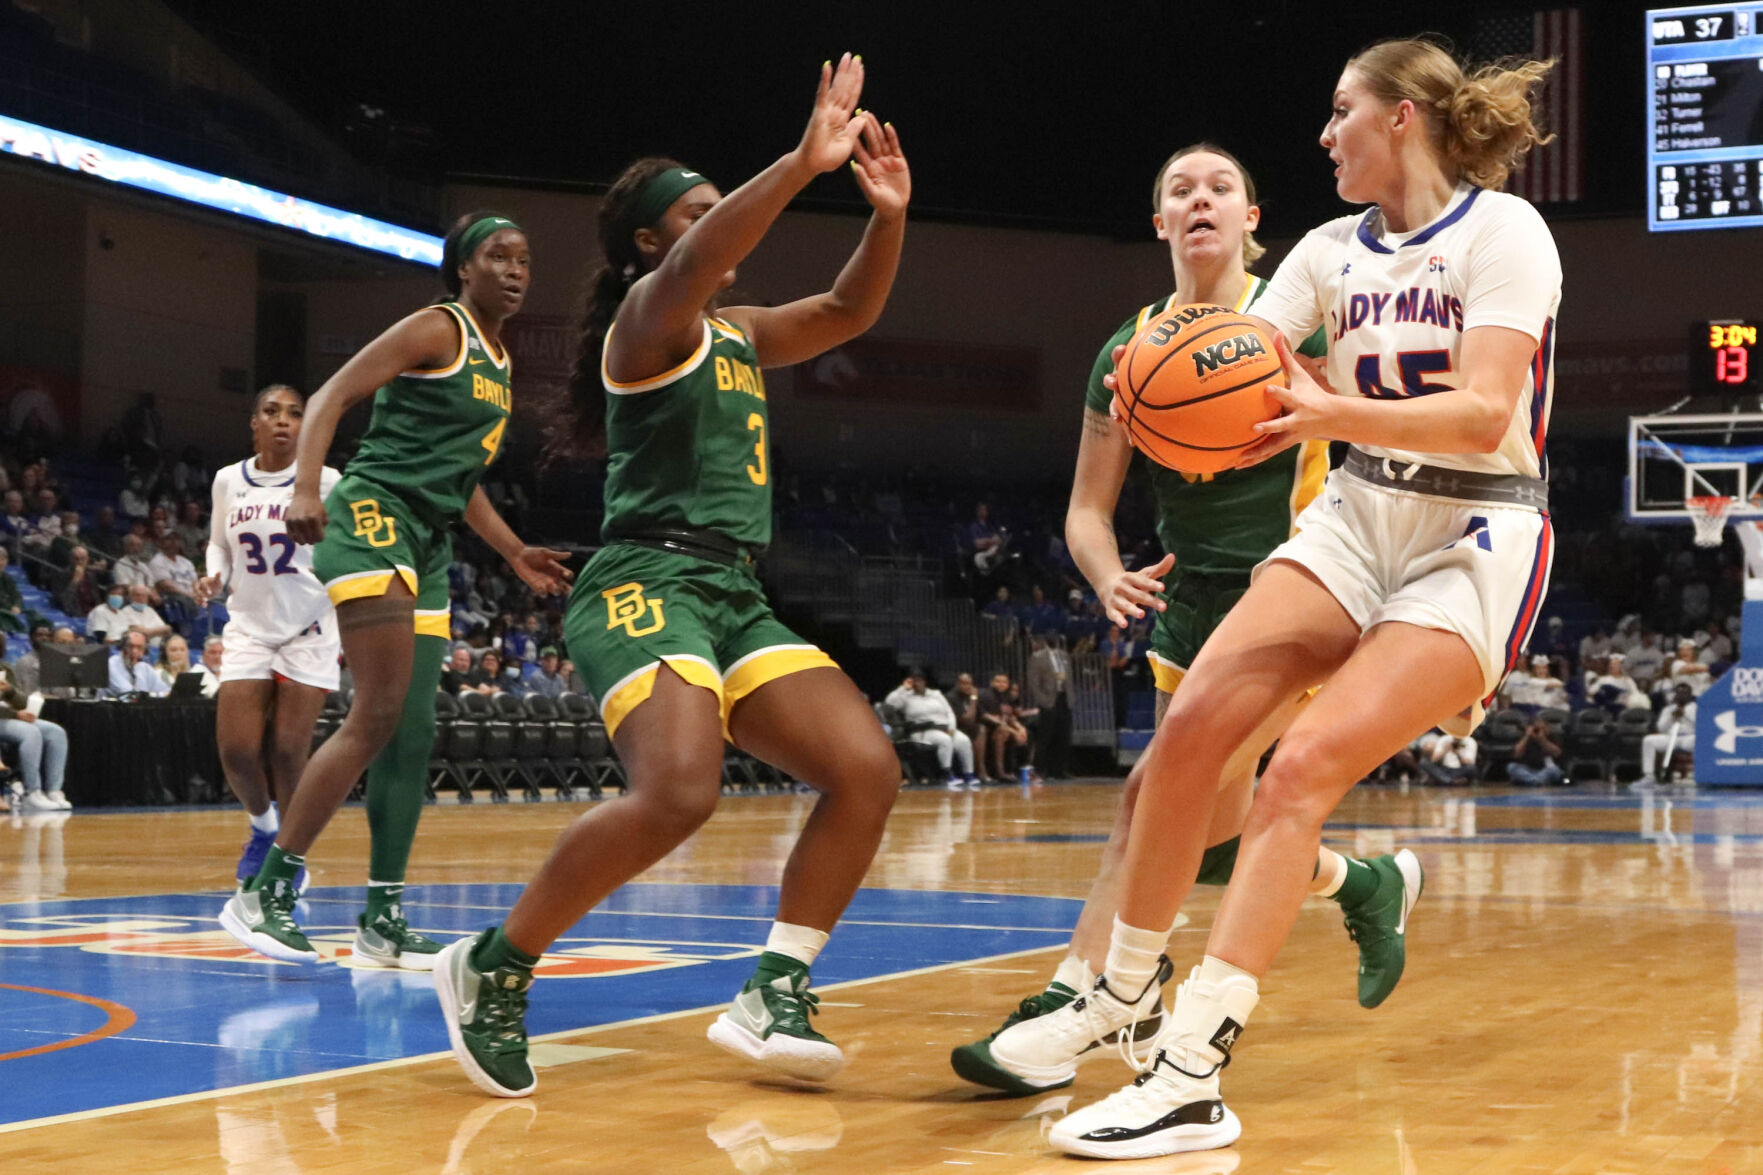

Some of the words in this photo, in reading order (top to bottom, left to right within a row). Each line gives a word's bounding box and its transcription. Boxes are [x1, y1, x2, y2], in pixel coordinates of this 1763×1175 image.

[1695, 18, 1723, 38] 37
[0, 122, 104, 174] AVS
[1395, 287, 1464, 333] MAVS
[1191, 332, 1267, 378] NCAA
[1710, 325, 1757, 349] 3:04
[1355, 349, 1457, 400] 45
[1716, 346, 1748, 384] 13
[481, 417, 507, 466] 4
[747, 412, 768, 486] 3
[230, 504, 264, 529] LADY
[238, 532, 298, 577] 32
[602, 582, 666, 638] BU
